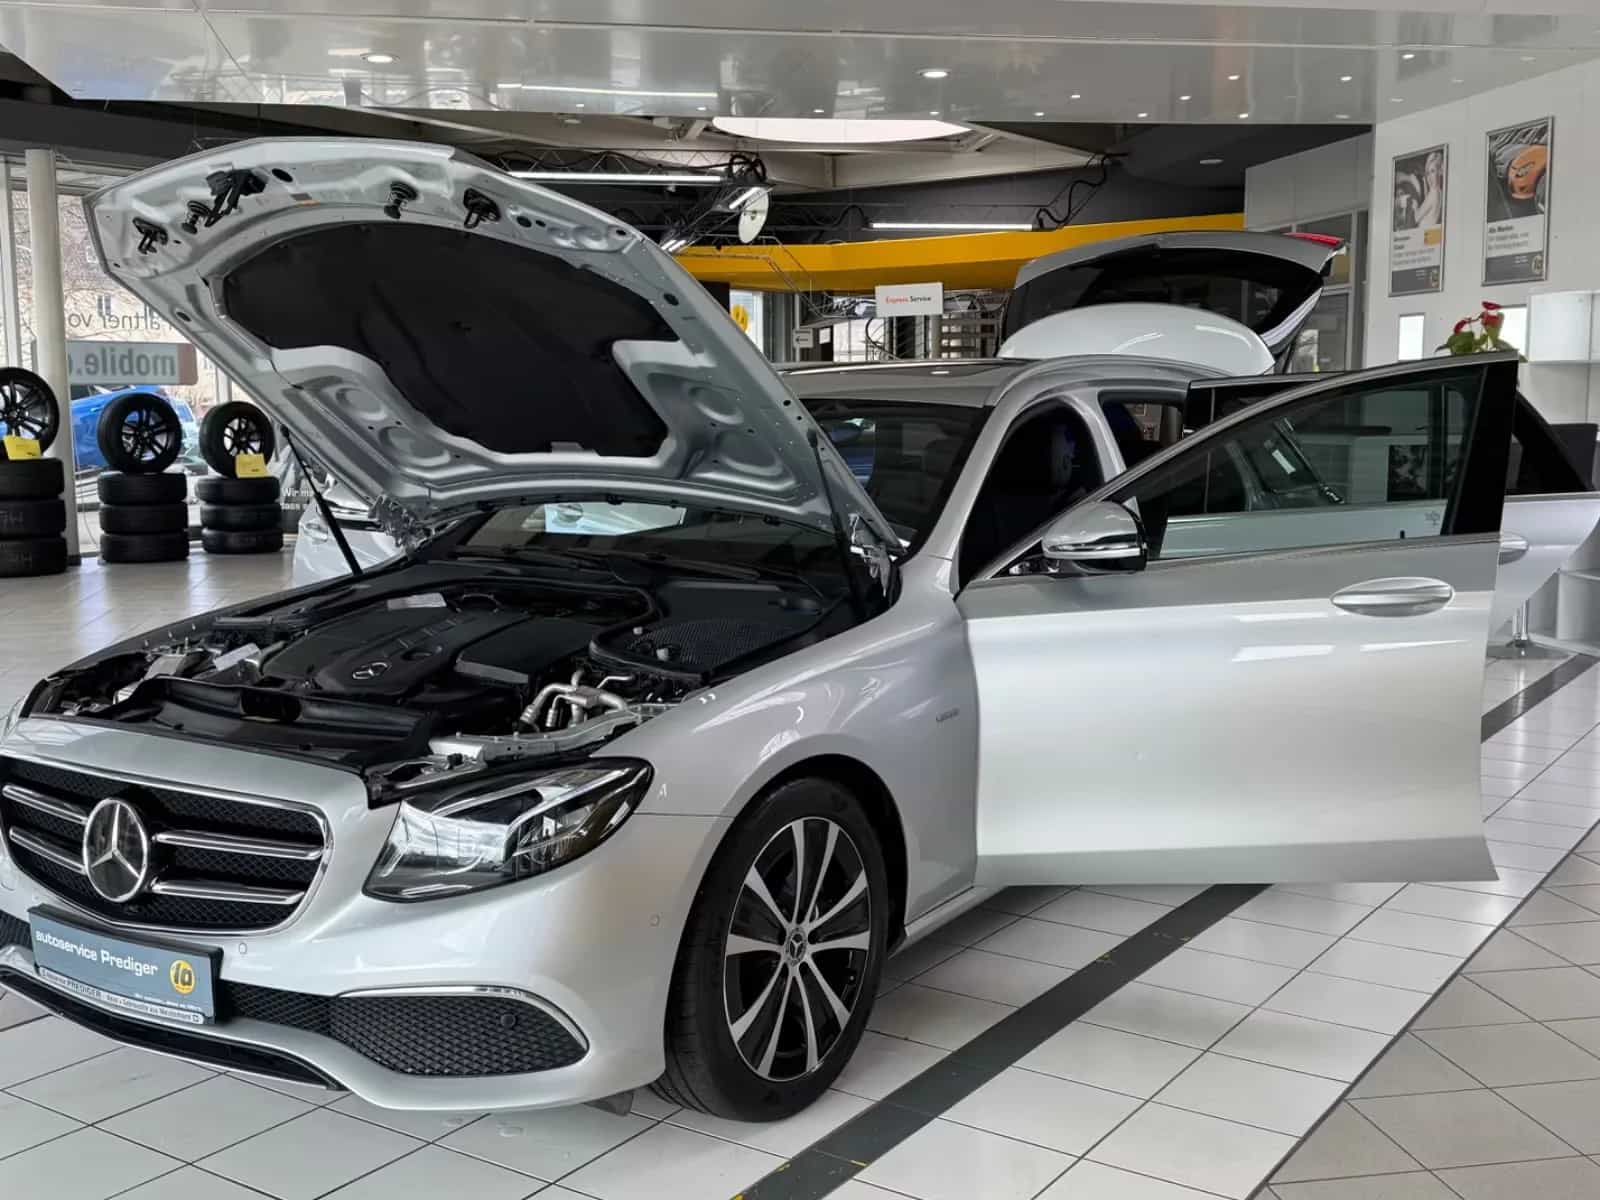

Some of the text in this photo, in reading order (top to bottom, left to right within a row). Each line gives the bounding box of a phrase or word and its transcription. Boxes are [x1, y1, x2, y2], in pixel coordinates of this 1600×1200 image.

[909, 295, 932, 303] Service
[35, 930, 158, 976] autoservice Prediger
